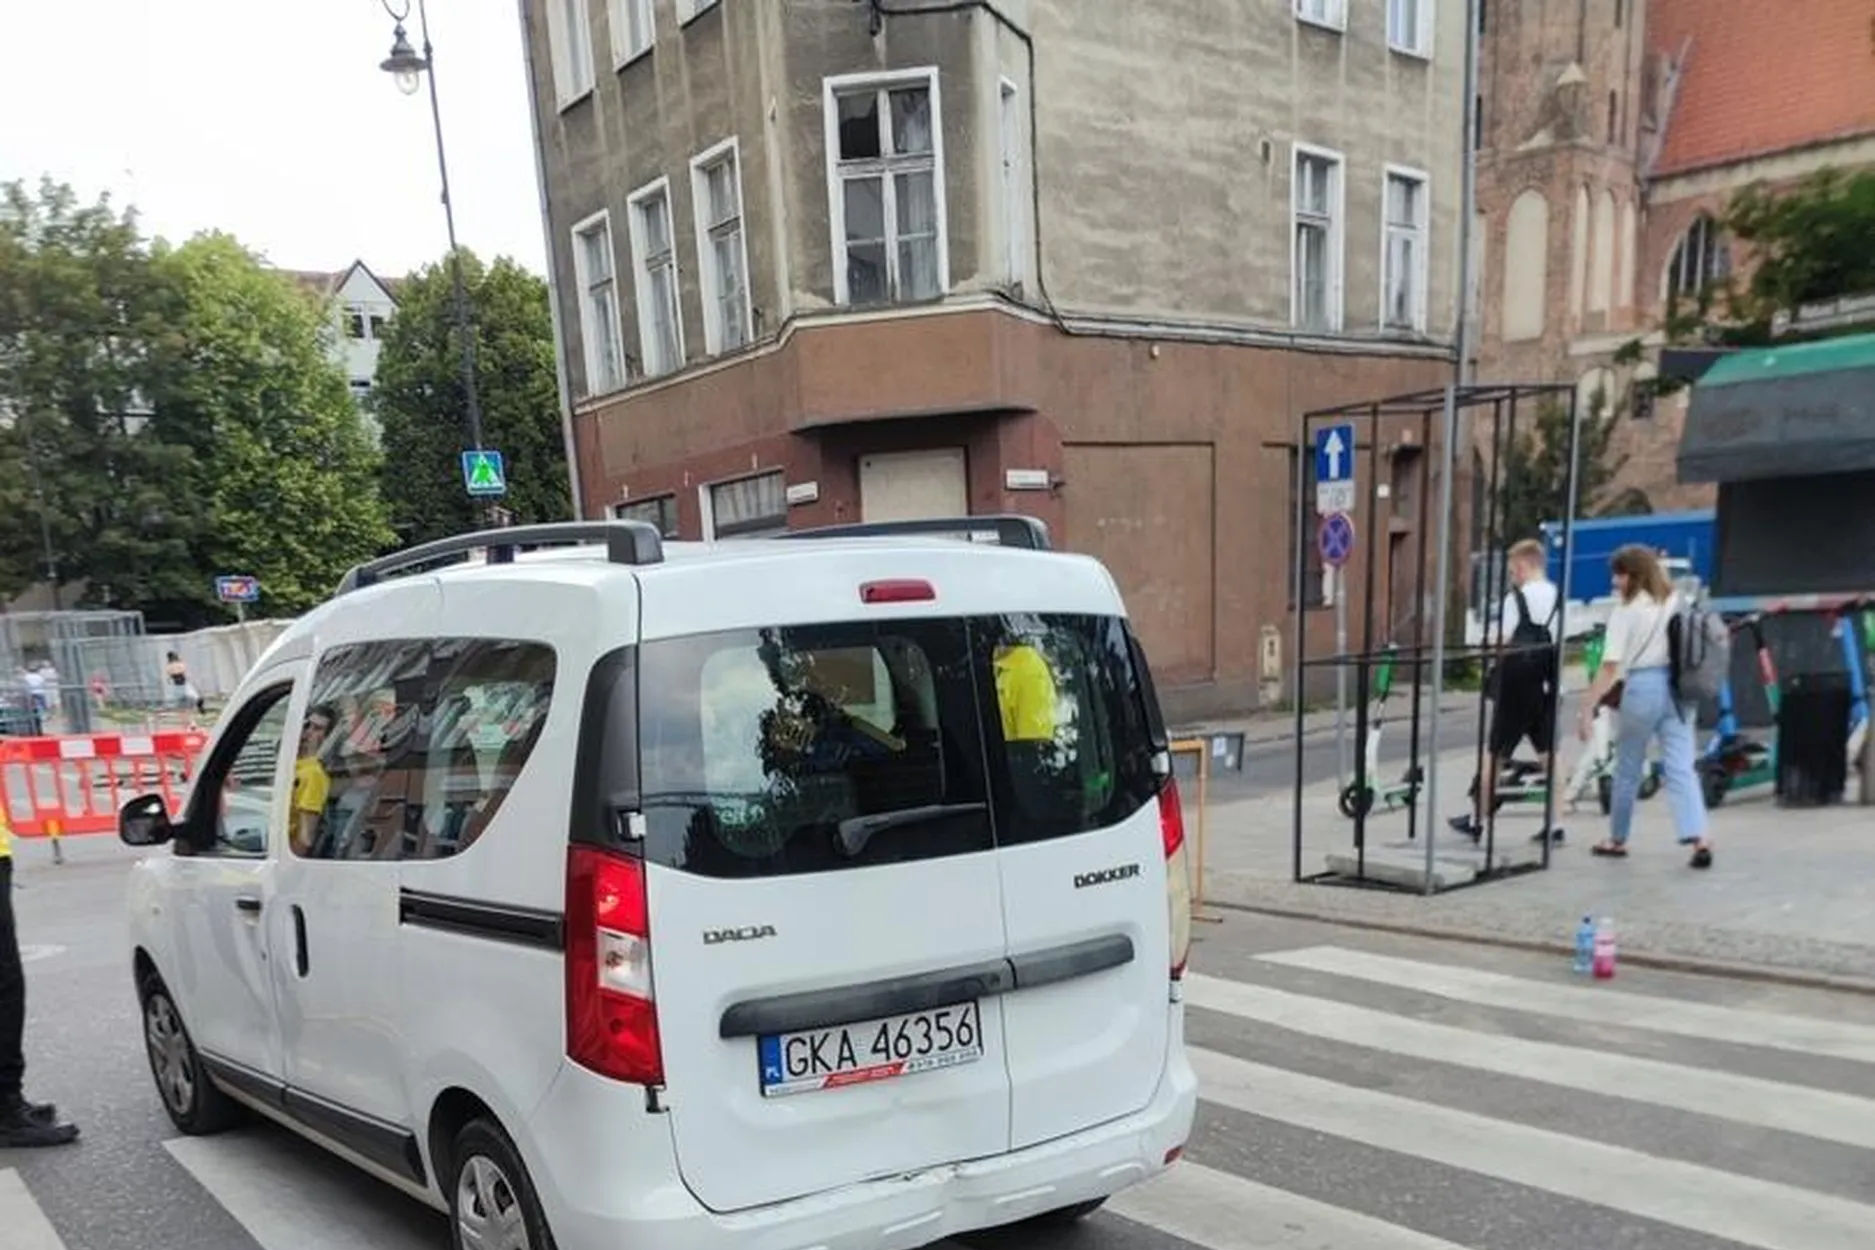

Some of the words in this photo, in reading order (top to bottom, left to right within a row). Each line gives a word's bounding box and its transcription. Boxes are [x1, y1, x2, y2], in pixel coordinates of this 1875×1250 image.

[1074, 863, 1140, 888] DOKKER
[703, 925, 777, 945] DACIA
[786, 1030, 857, 1076] GKA
[870, 1007, 974, 1061] 46356
